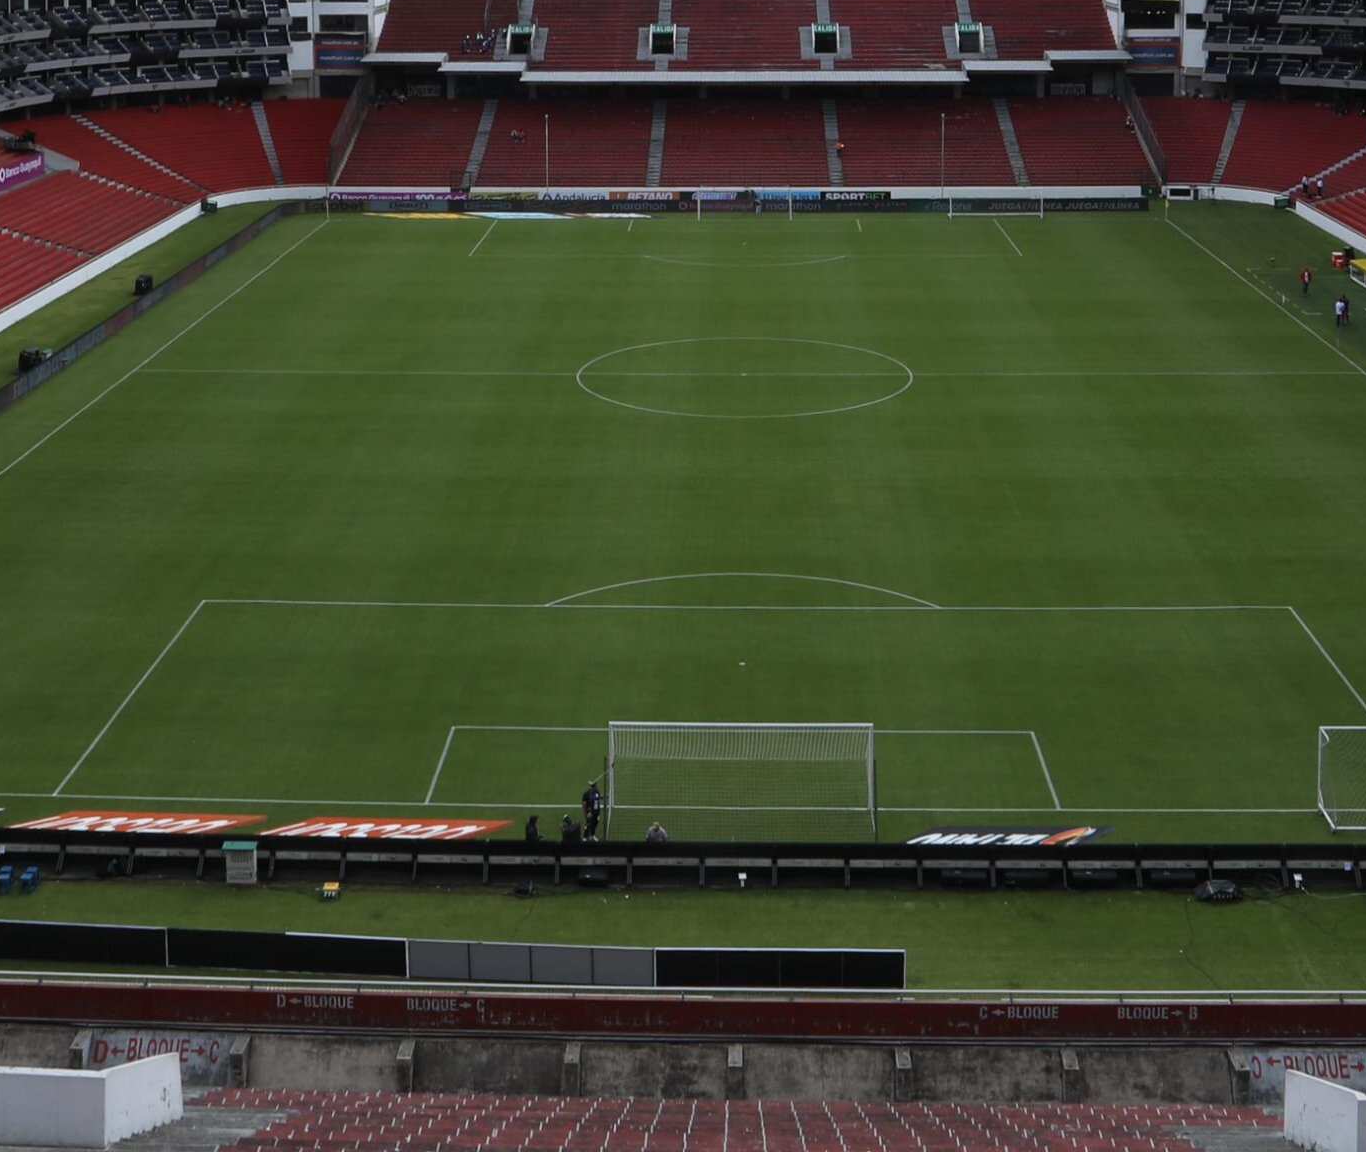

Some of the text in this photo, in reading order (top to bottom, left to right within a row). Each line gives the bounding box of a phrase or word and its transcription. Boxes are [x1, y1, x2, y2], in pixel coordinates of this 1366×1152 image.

[276, 995, 354, 1009] D BLOQUE
[407, 998, 456, 1011] BLOQUE
[1007, 1007, 1059, 1020] BLOQUE
[1118, 1007, 1169, 1020] BLOQUE
[93, 1039, 109, 1064] D
[209, 1040, 220, 1064] C
